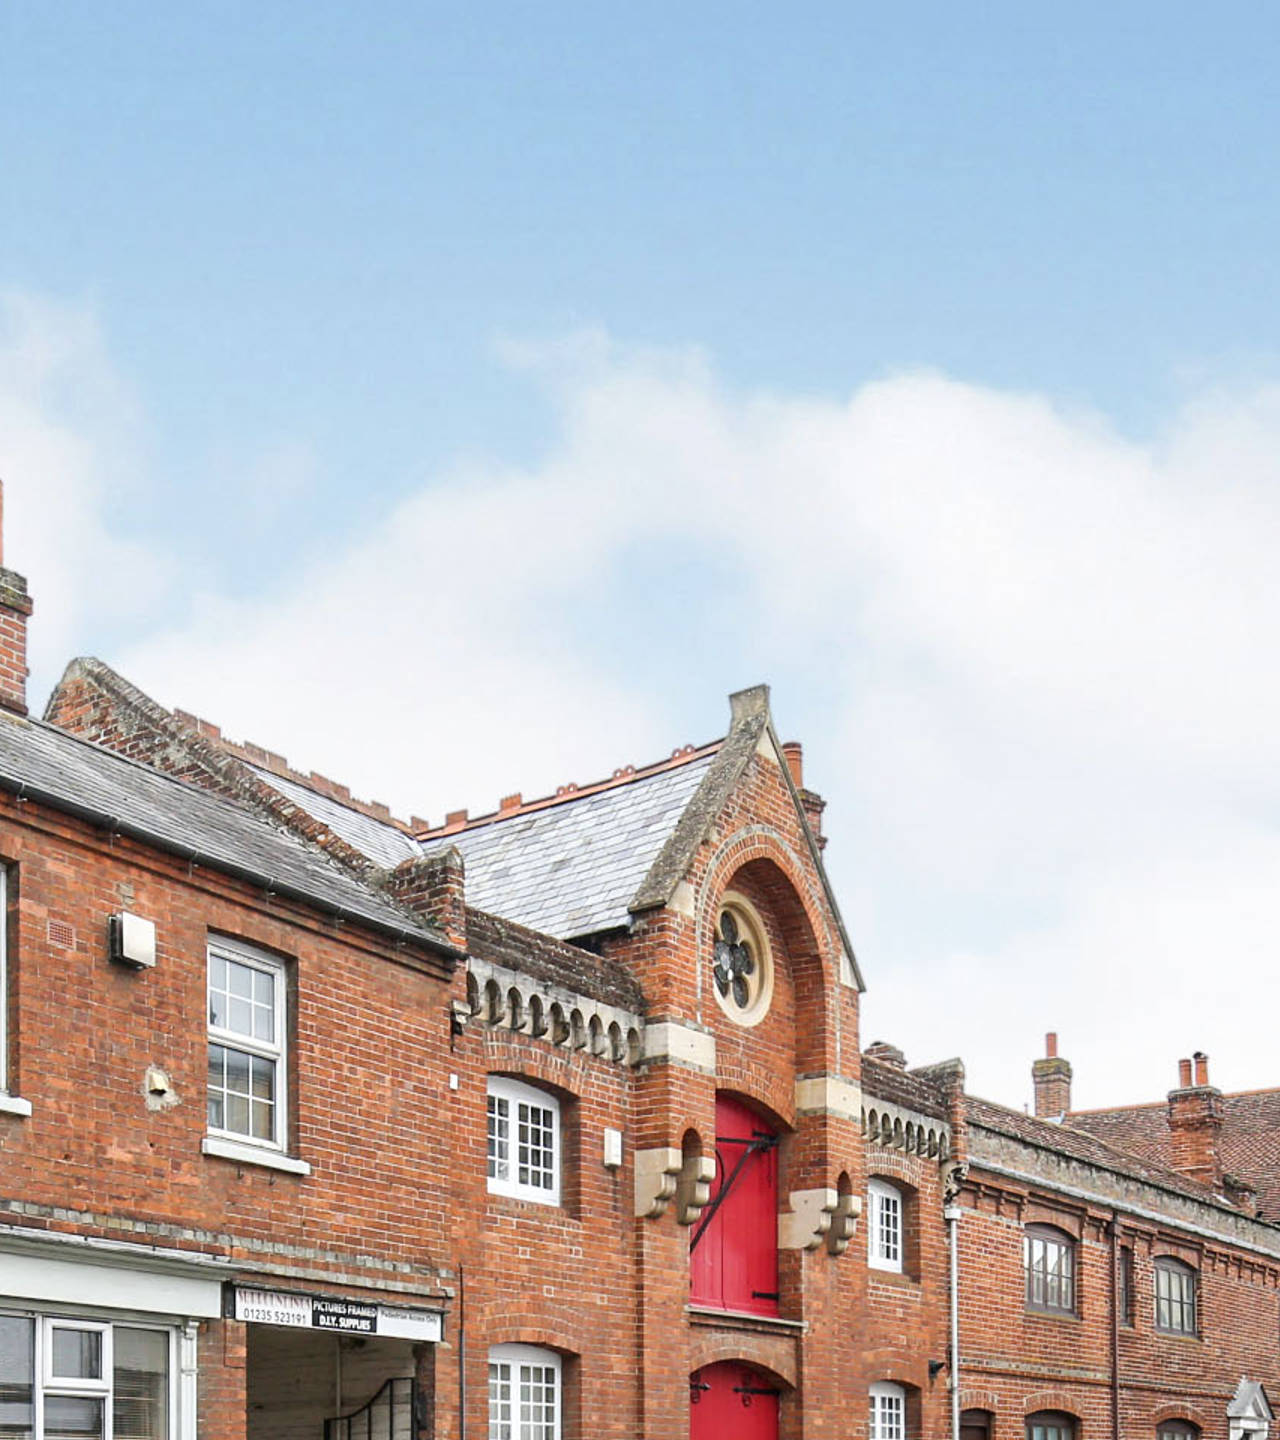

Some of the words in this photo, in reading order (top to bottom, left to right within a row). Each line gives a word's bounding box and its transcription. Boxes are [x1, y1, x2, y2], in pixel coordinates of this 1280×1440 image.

[243, 1307, 273, 1321] 01235
[273, 1310, 307, 1326] 523191
[312, 1300, 347, 1315] PICTURES
[347, 1304, 378, 1318] FRAMED
[339, 1316, 372, 1331] SUPPLIES
